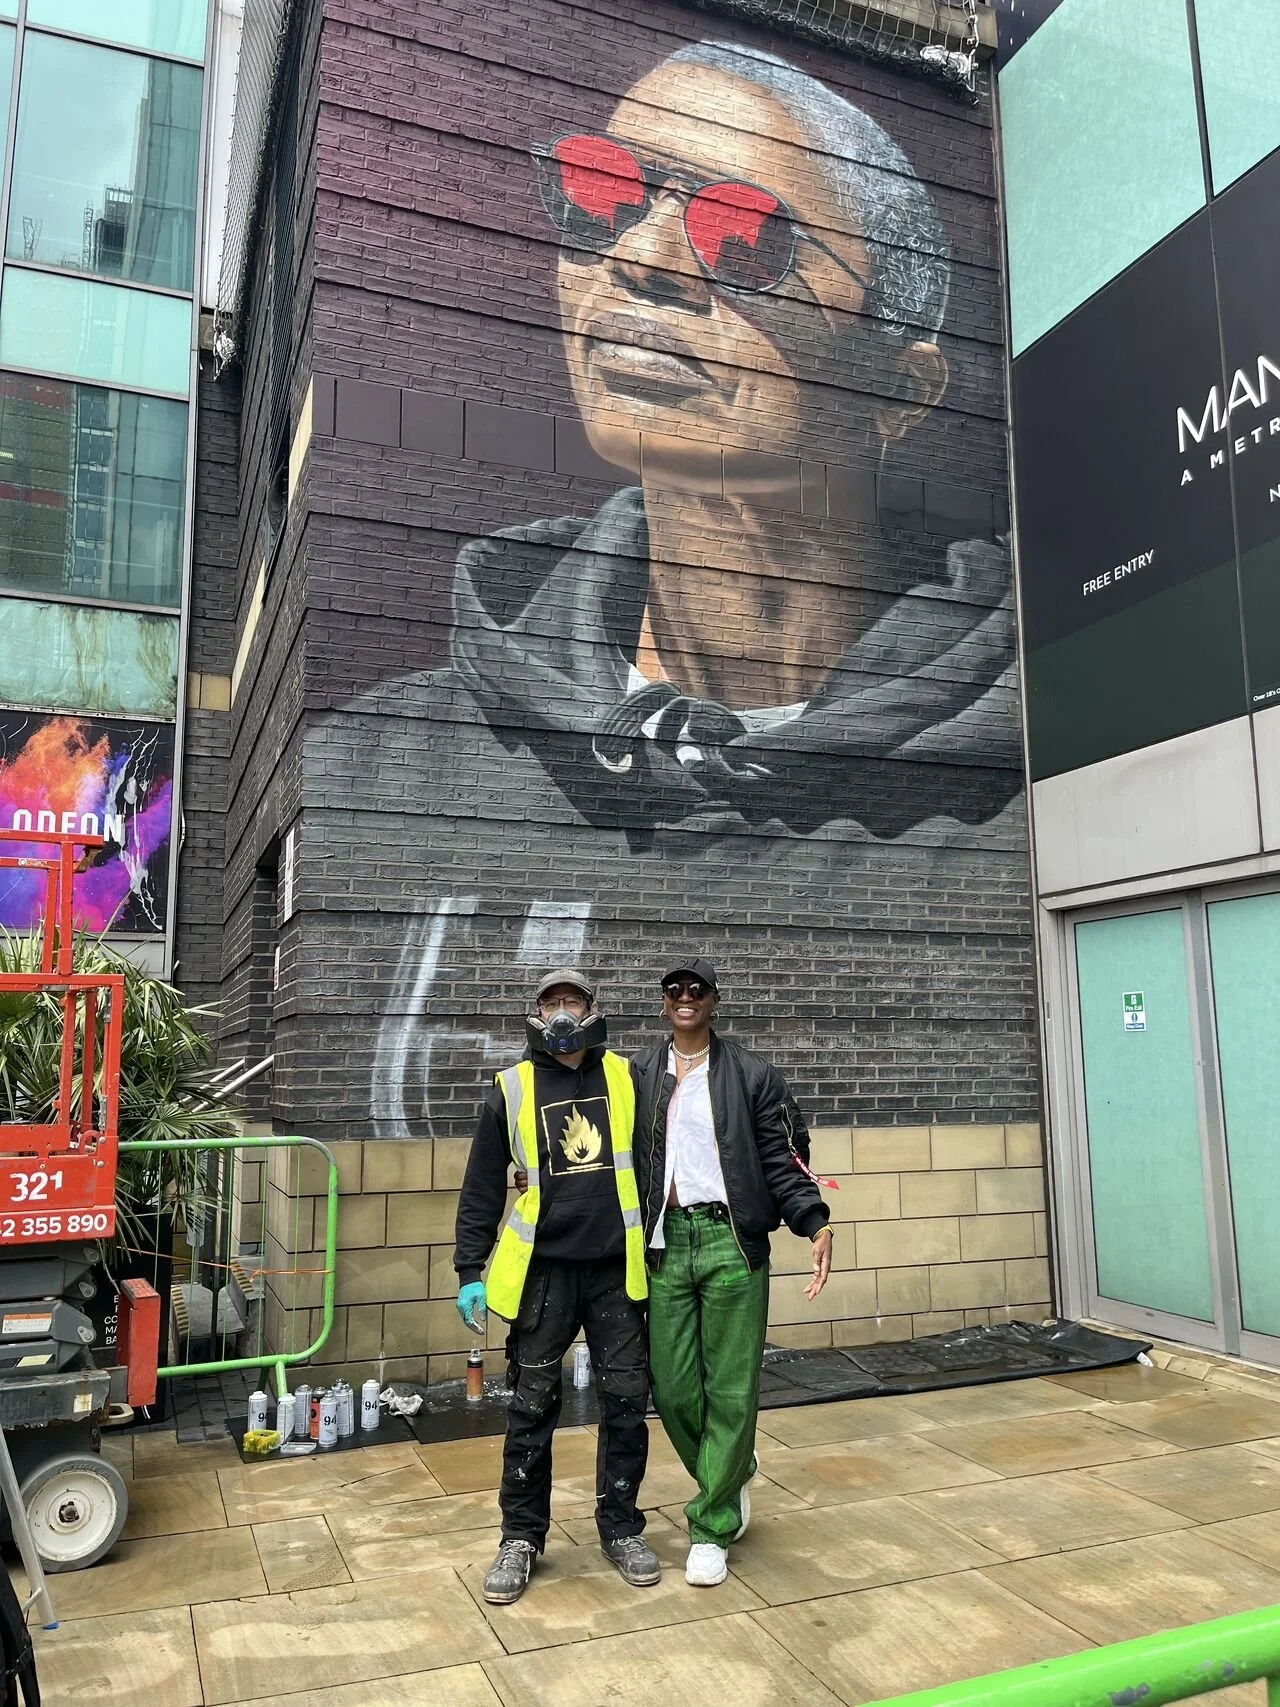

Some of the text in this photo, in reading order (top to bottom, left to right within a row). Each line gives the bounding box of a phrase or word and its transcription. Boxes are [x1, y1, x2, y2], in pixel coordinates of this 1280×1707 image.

[1180, 416, 1280, 486] A METR
[1083, 549, 1154, 596] FREE ENTRY
[13, 809, 123, 842] ODEON
[9, 1171, 63, 1202] 321
[0, 1213, 108, 1237] 2 355 890
[323, 1414, 337, 1426] 94
[364, 1400, 378, 1411] 94
